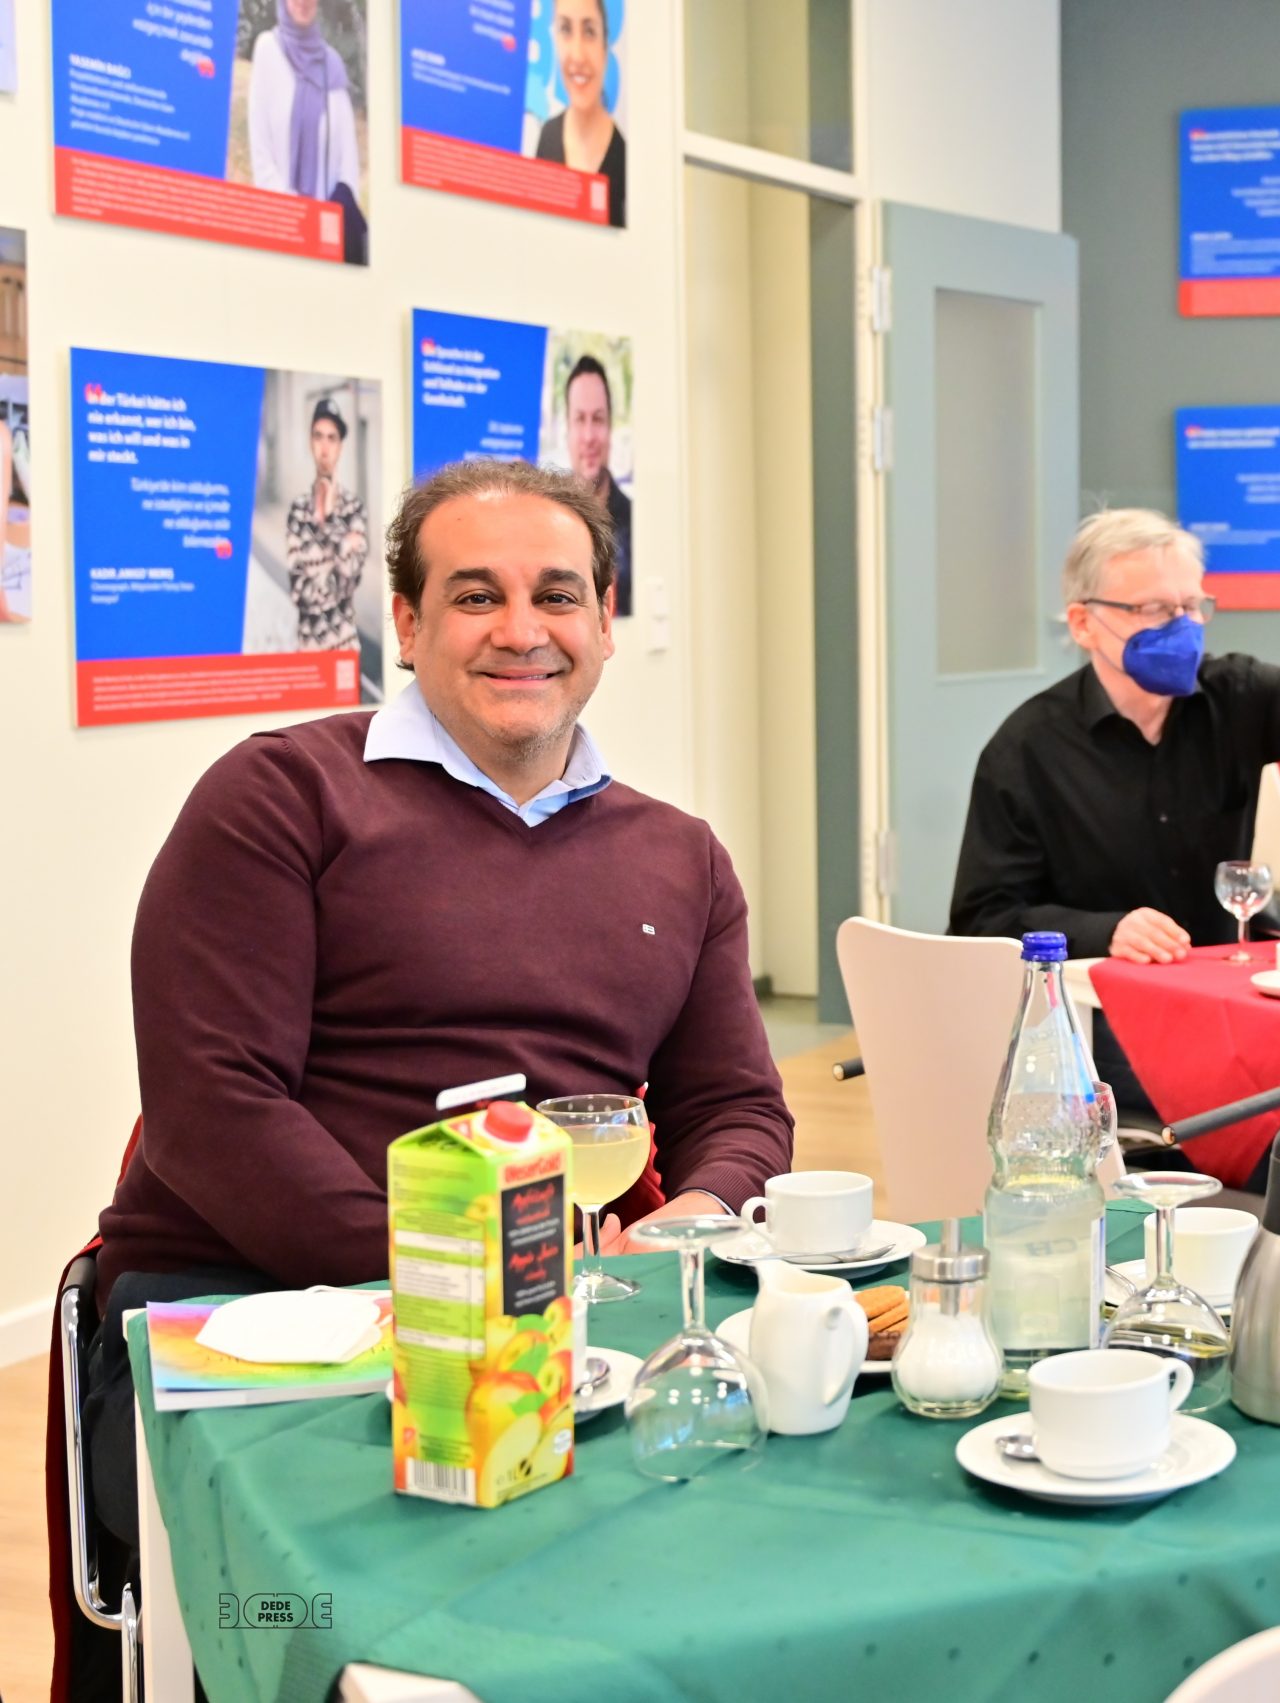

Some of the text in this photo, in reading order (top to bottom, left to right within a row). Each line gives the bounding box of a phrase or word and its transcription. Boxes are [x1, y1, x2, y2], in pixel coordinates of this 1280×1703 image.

[117, 393, 145, 409] Türkei
[172, 398, 187, 412] ich
[163, 416, 178, 431] ich
[88, 431, 107, 444] was
[108, 430, 123, 445] ich
[142, 432, 161, 447] und
